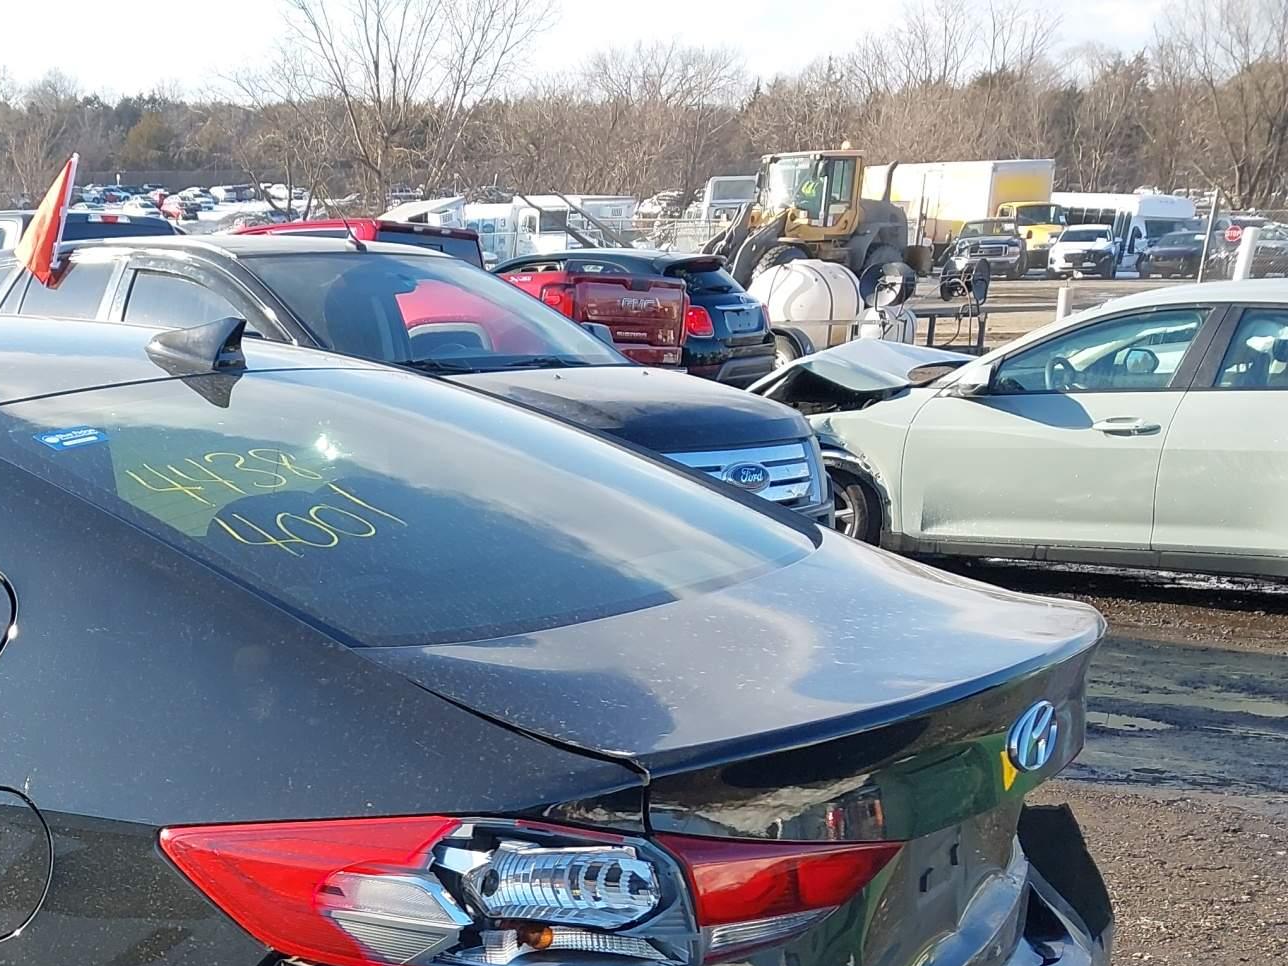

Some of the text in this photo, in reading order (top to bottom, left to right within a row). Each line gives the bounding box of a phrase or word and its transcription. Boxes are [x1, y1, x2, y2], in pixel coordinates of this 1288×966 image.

[125, 448, 324, 507] 4438
[740, 467, 764, 483] Ford
[214, 481, 409, 559] 4001
